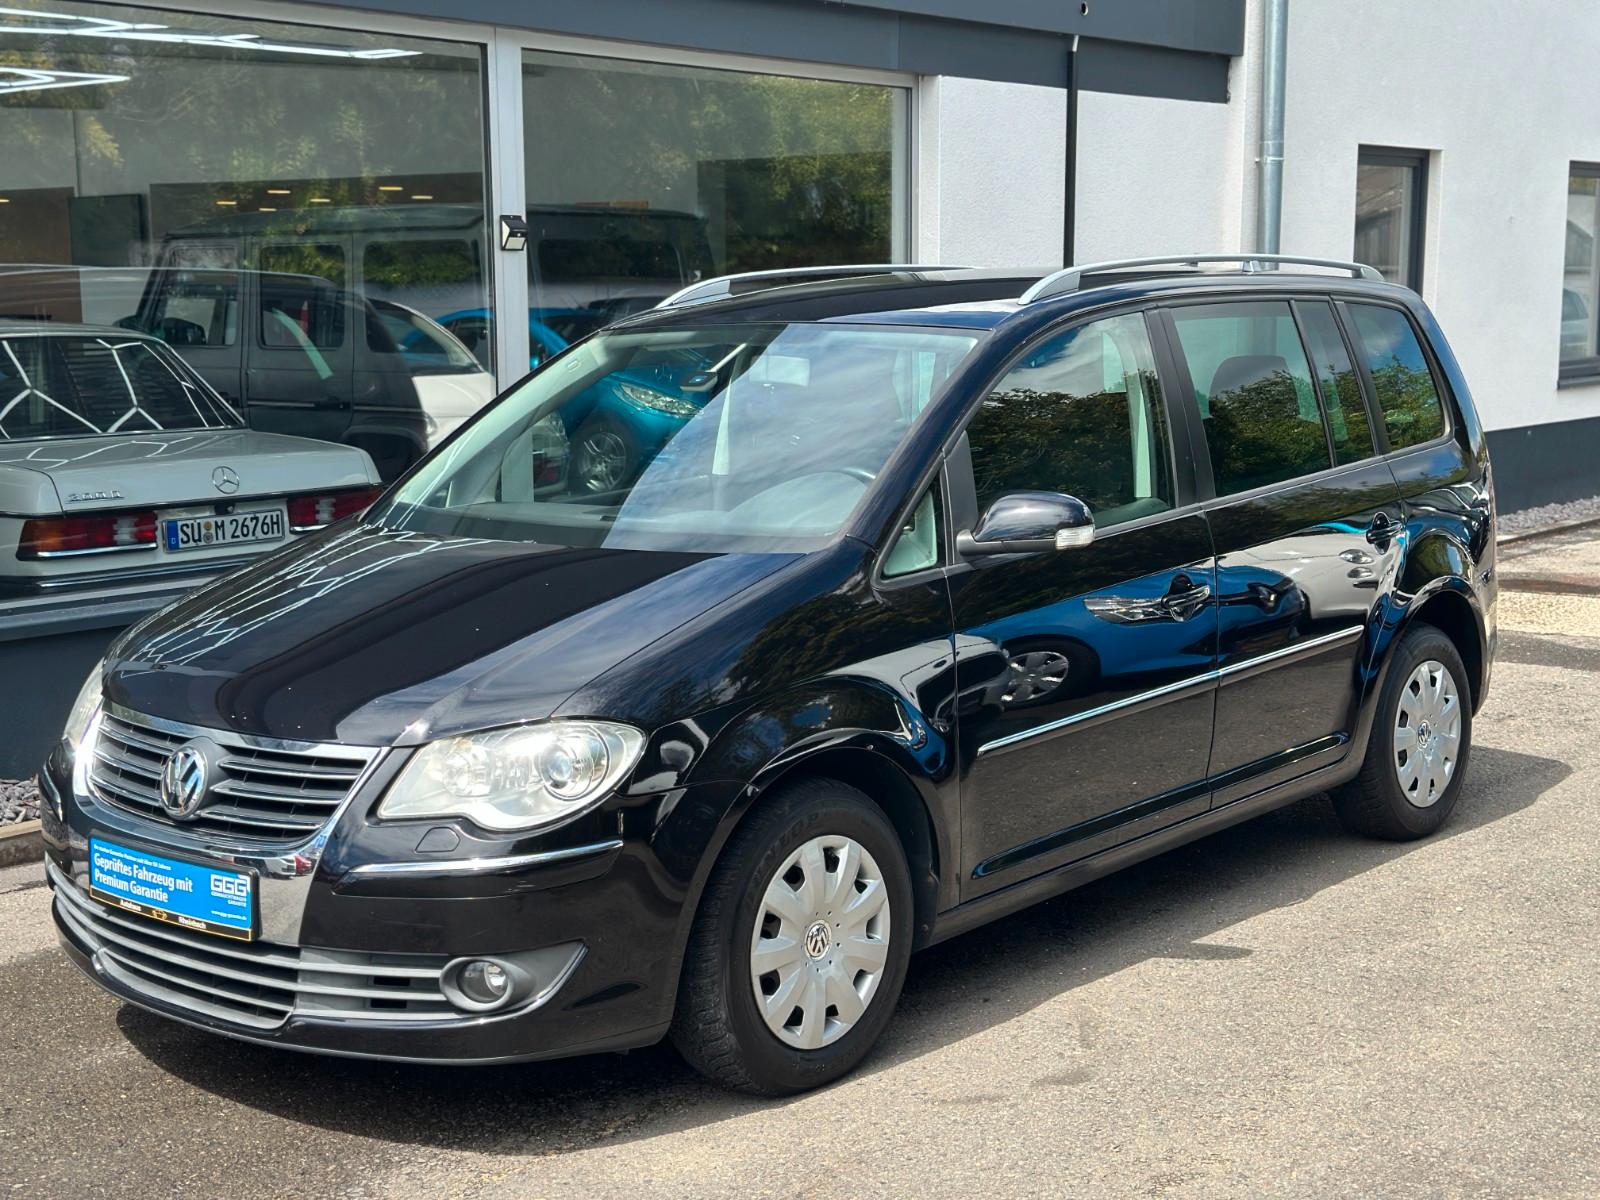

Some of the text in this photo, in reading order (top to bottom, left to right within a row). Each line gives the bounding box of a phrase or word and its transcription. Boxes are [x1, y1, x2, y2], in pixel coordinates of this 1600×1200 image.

[180, 513, 281, 544] SU M 2676H
[94, 853, 132, 876] Geprüftes
[133, 864, 175, 891] Fahrzeug
[176, 876, 193, 893] mit
[95, 868, 169, 903] Premium Garantie
[210, 873, 247, 897] GGG
